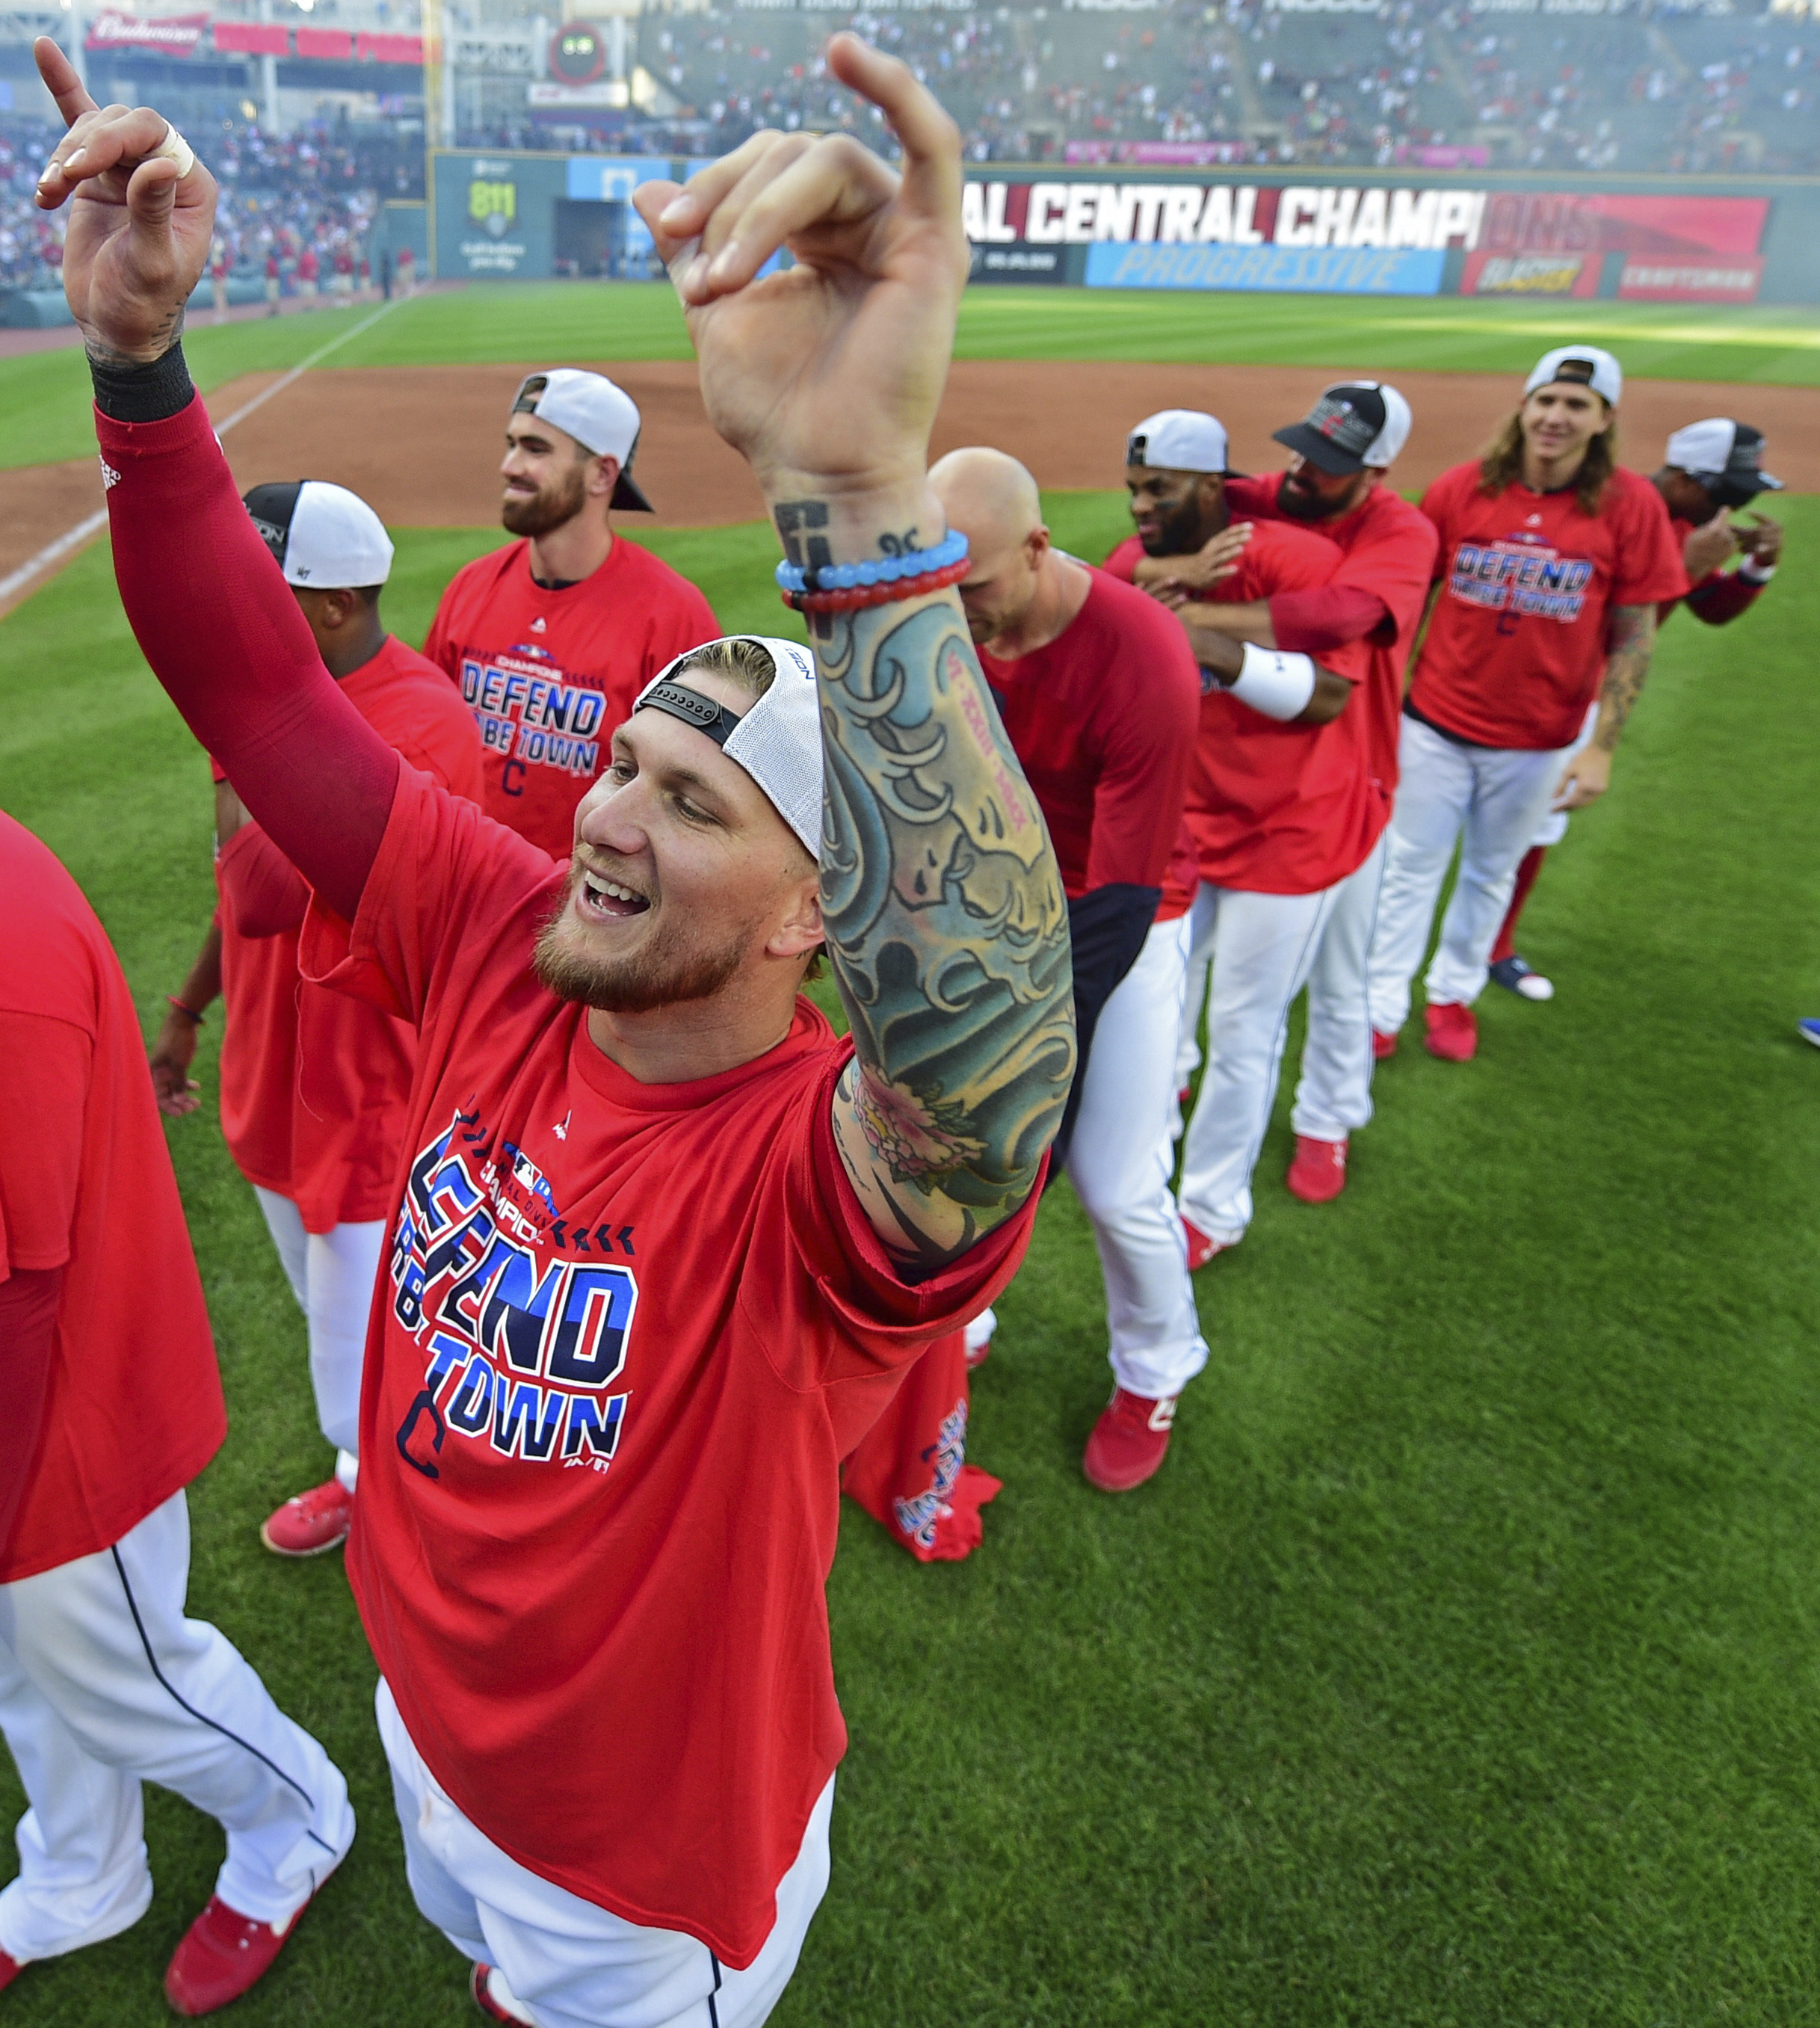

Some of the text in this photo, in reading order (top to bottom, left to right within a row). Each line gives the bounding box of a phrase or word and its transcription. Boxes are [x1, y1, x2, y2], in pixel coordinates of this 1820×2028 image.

[470, 182, 517, 219] 811
[1025, 182, 1265, 245] CENTRAL
[1113, 247, 1408, 288] PROGRESSIVE
[1455, 543, 1594, 593] DEFEND
[460, 659, 607, 740] DEFEND
[516, 727, 599, 774] TOWN
[502, 758, 525, 797] C
[424, 1330, 629, 1461] TOWN
